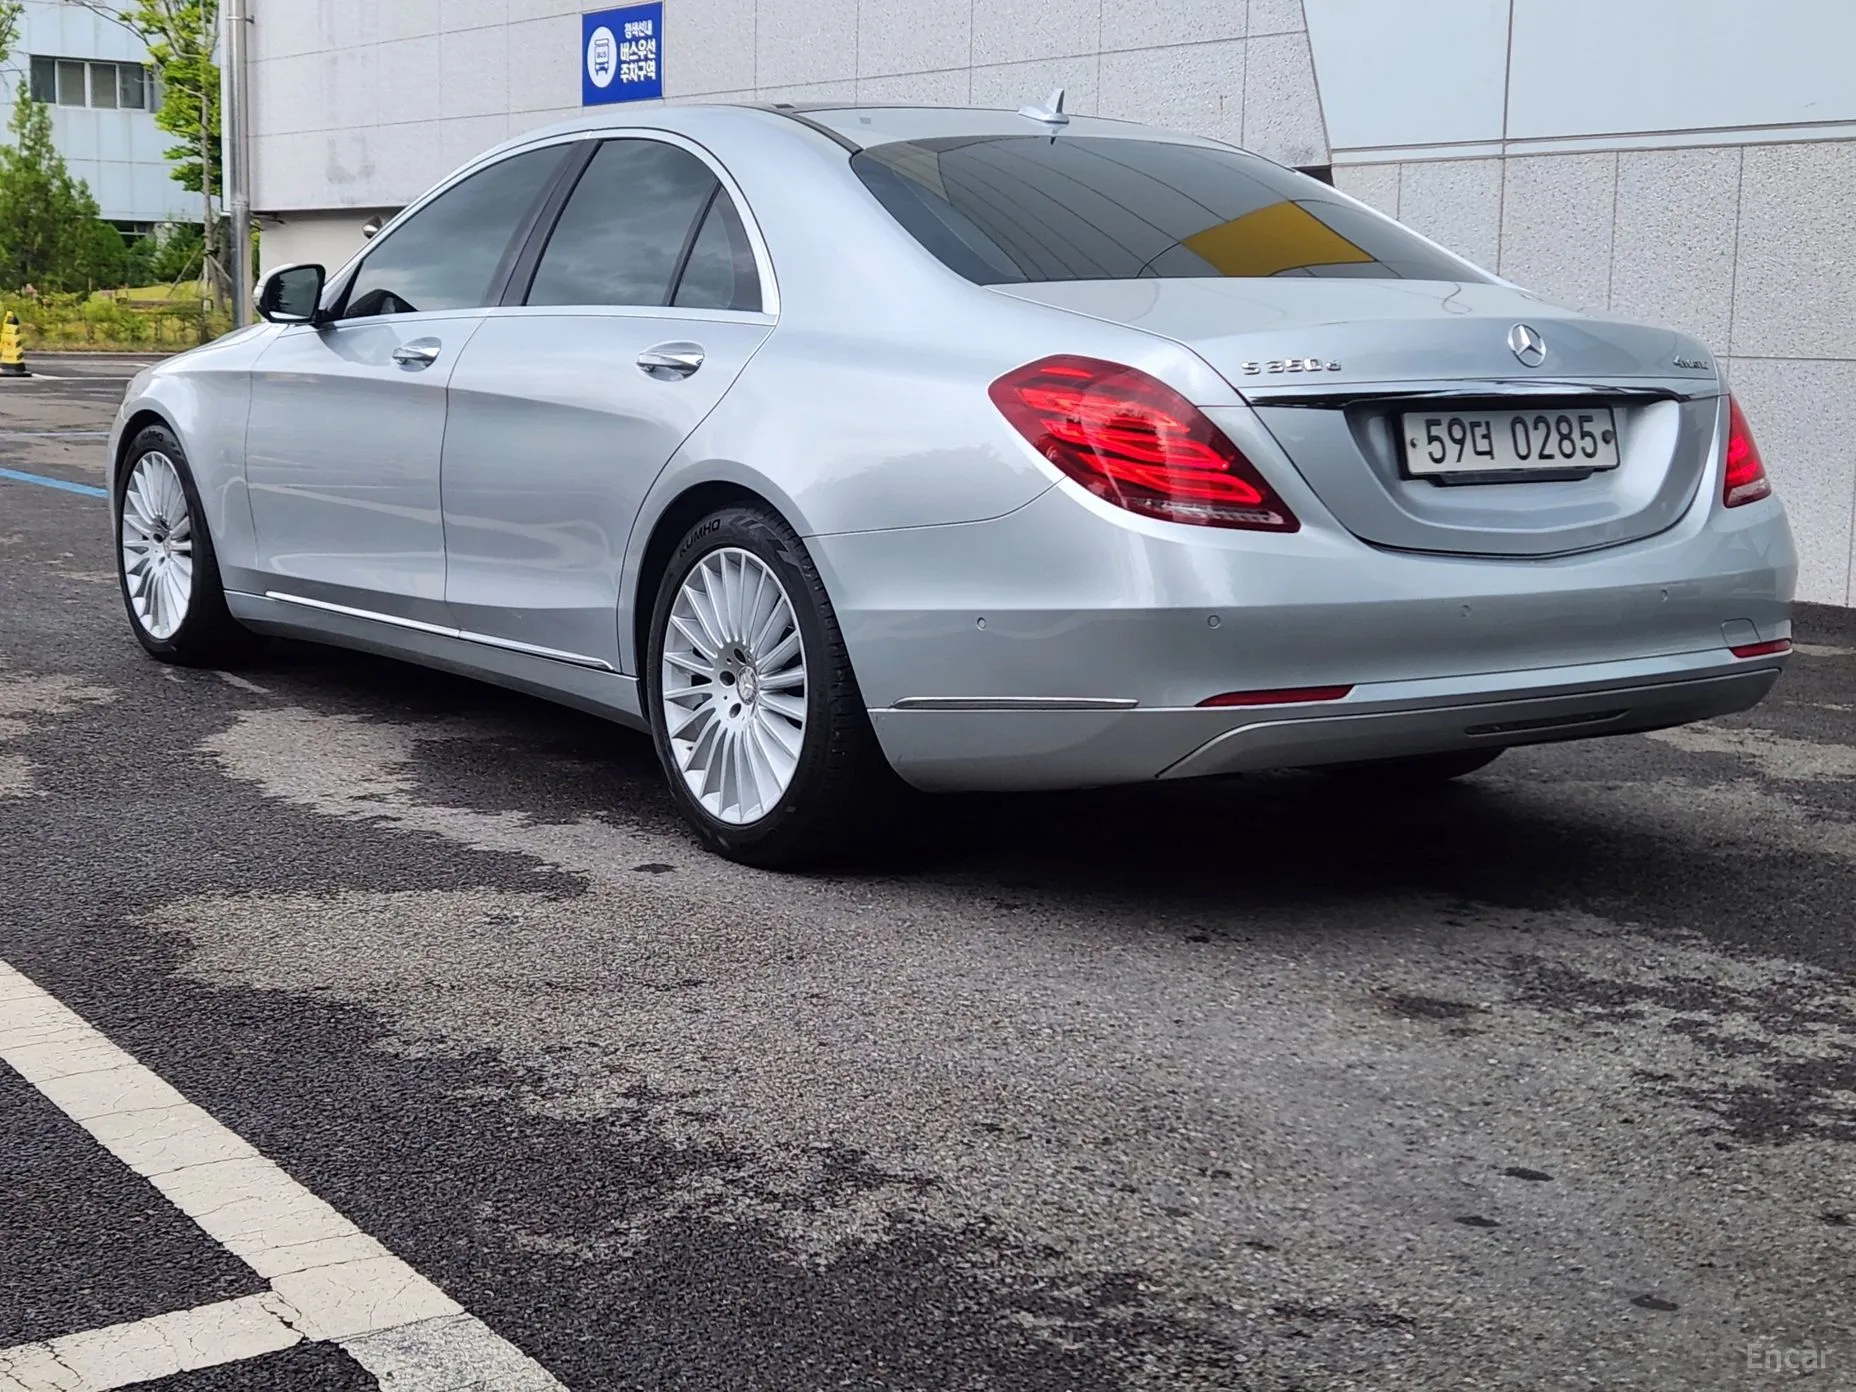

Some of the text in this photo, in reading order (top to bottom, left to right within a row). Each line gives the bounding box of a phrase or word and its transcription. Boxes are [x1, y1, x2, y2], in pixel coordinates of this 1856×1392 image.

[620, 39, 656, 61] 버스우선
[620, 60, 656, 83] 주차구역
[1425, 415, 1598, 464] 59더 0285
[679, 518, 721, 557] KUMHO
